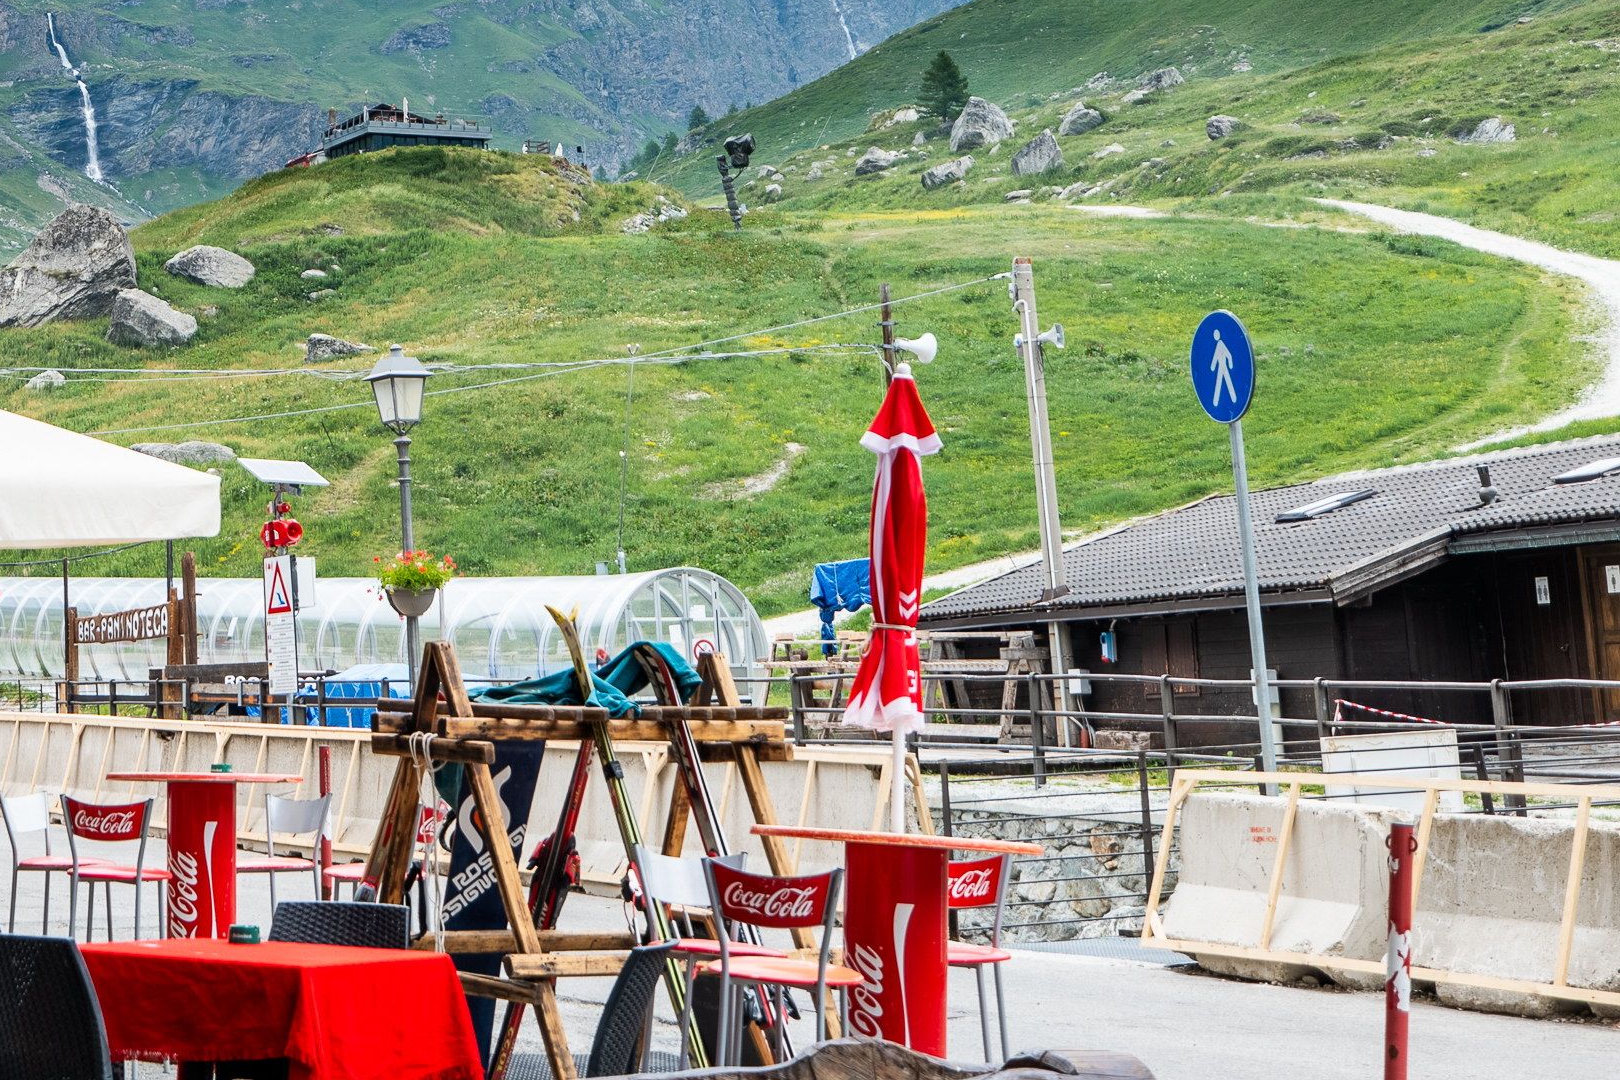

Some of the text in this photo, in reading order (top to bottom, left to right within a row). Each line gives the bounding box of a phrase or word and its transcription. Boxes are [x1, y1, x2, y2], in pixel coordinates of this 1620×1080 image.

[74, 809, 136, 834] Coca-Cola
[167, 843, 198, 939] a-Cola
[724, 881, 818, 918] Coca-Cola
[948, 867, 994, 898] -Cola
[844, 942, 884, 1041] Cola
